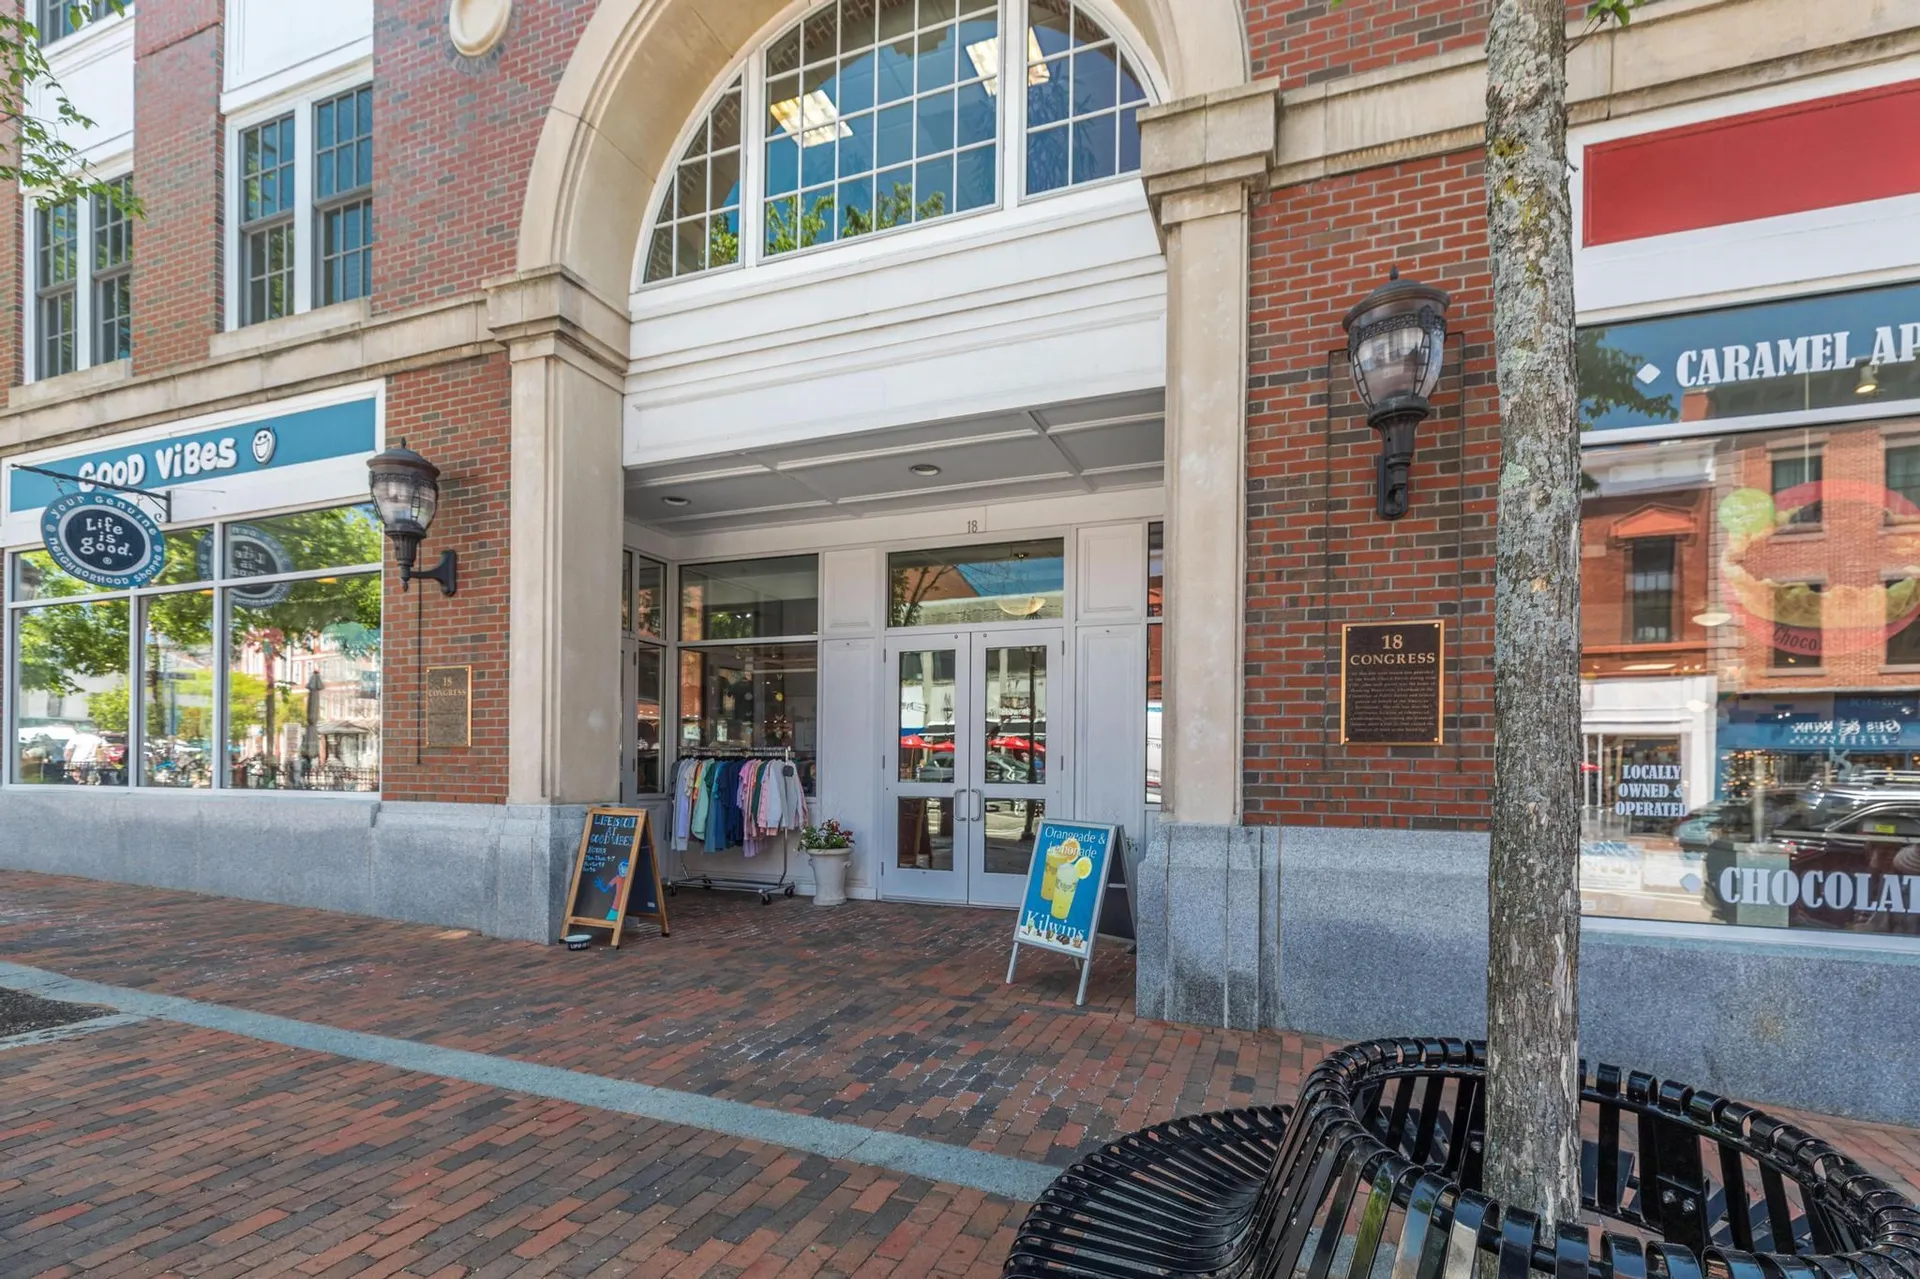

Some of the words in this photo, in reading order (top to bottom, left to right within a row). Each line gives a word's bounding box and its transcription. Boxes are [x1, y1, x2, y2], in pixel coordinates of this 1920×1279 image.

[1676, 331, 1856, 388] CARAMEL
[78, 453, 146, 493] GOOD
[86, 517, 124, 536] Life
[967, 519, 978, 534] 18
[98, 531, 117, 544] is
[1381, 633, 1403, 650] 18
[1350, 652, 1435, 666] CONGRESS
[443, 676, 453, 687] 18
[428, 688, 466, 698] CONGRESS
[1622, 764, 1682, 780] LOCALLY
[1618, 783, 1670, 798] OWNED
[1673, 784, 1684, 798] &
[1615, 801, 1688, 817] OPERATED
[1044, 826, 1096, 844] Orangeade
[1098, 832, 1107, 845] &
[1049, 842, 1097, 859] Lemonade
[1719, 866, 1920, 915] CHOCOLAT
[1026, 910, 1087, 941] Kilwins
